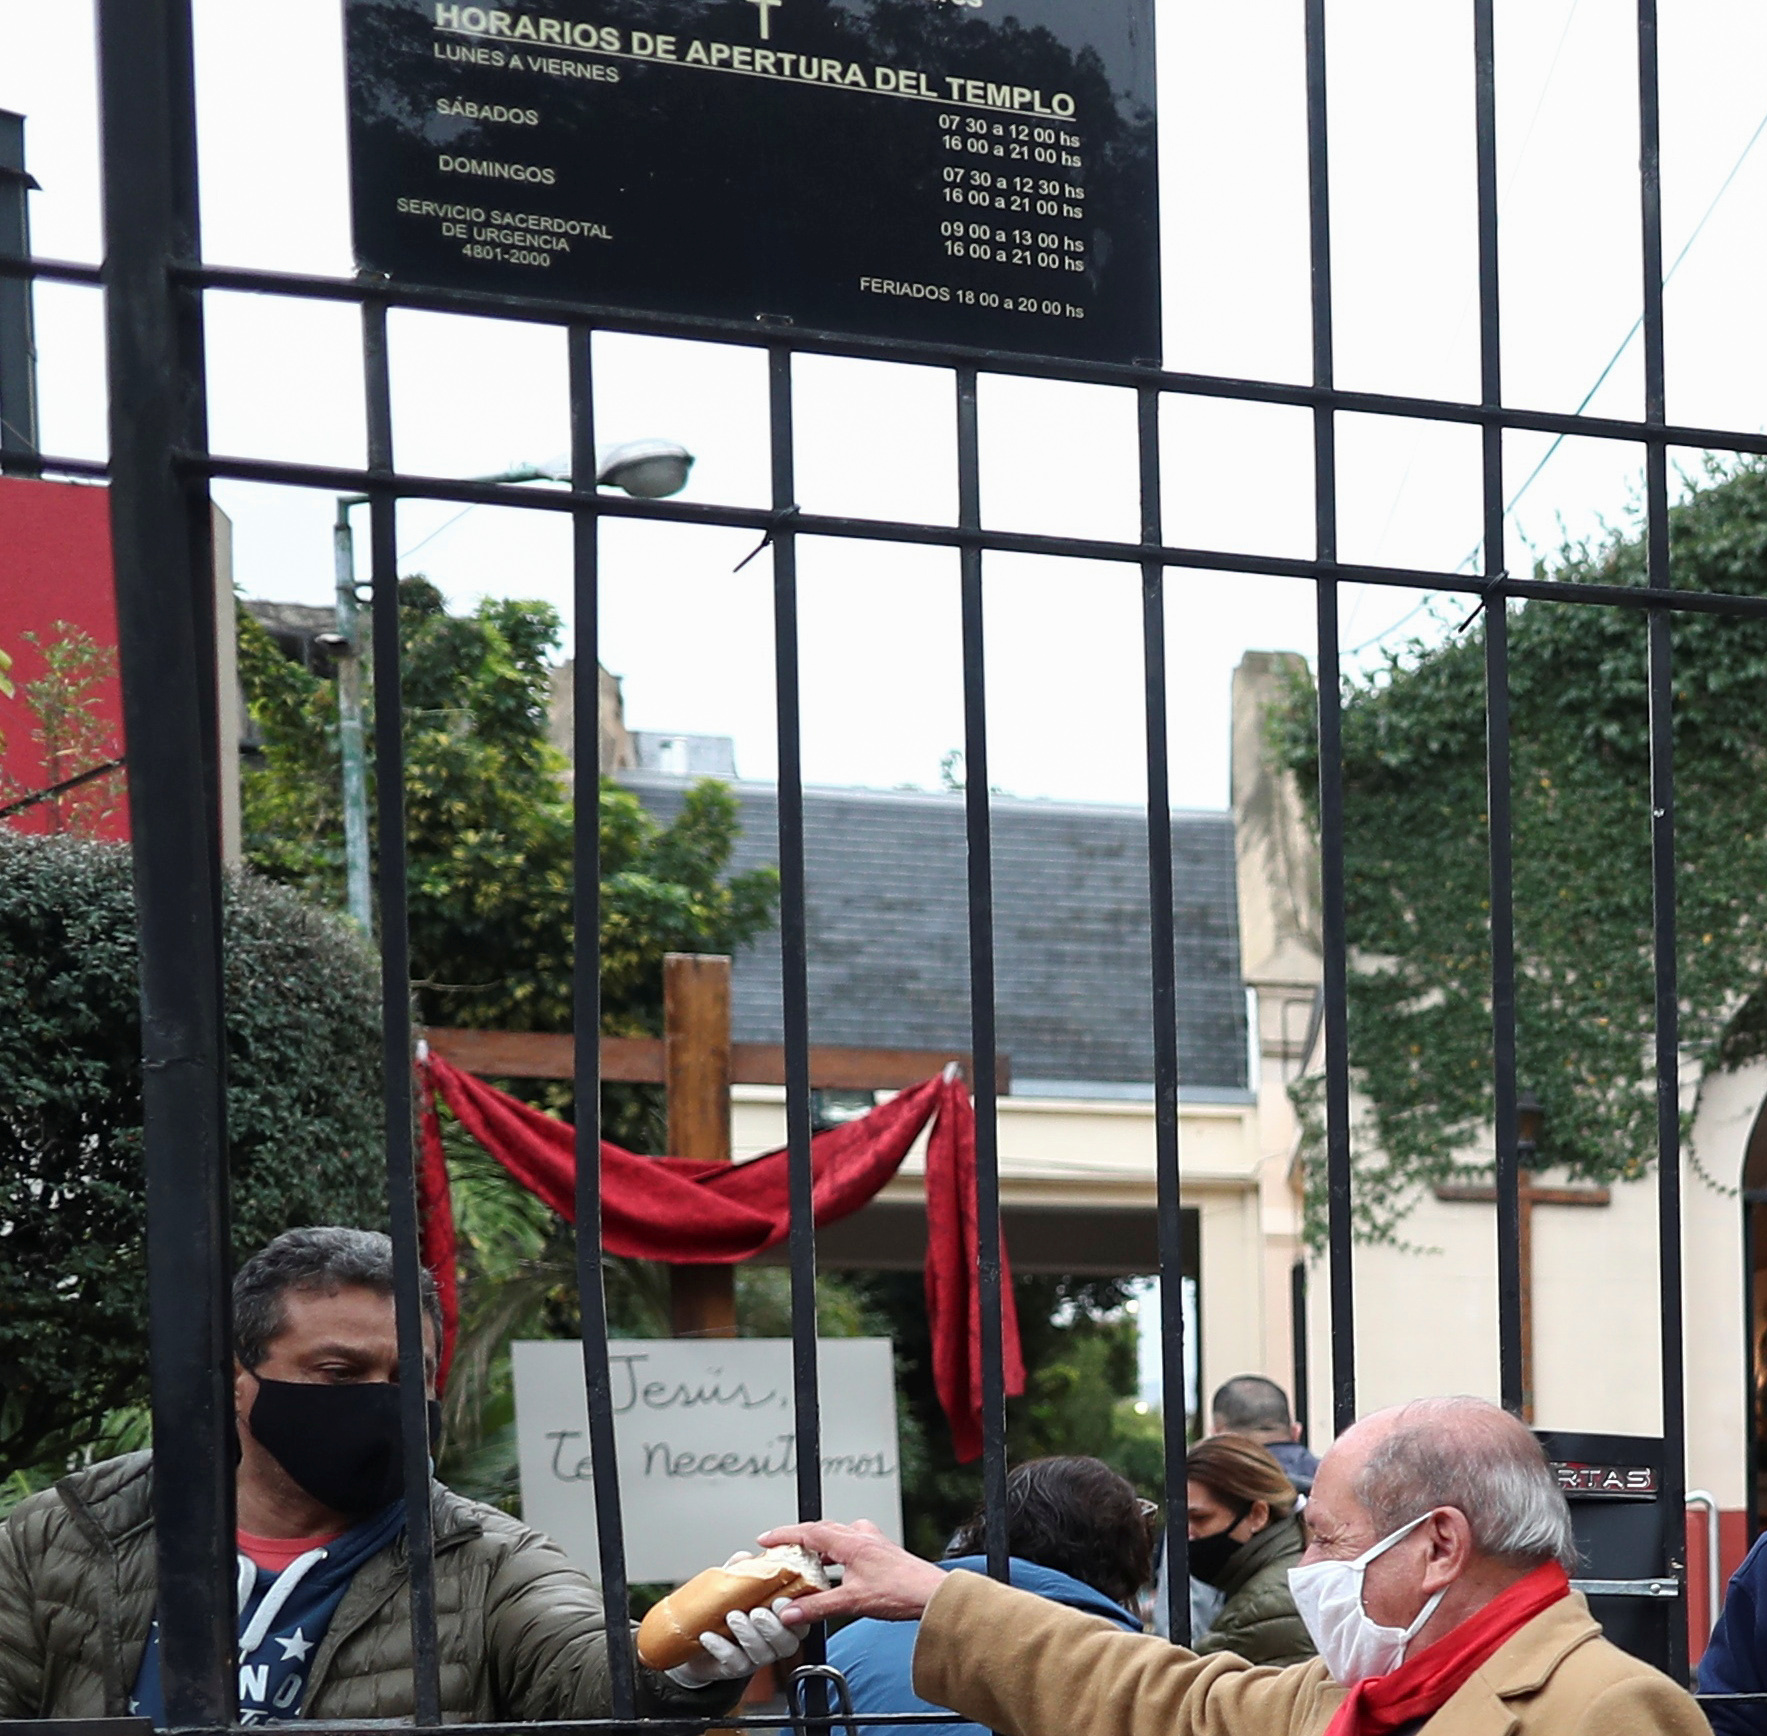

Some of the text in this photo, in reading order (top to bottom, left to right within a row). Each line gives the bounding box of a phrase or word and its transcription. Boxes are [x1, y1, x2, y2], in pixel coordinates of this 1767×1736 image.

[434, 42, 620, 83] LUNES A VIERNES
[435, 3, 1075, 116] HORARIOS DE APERTURA DEL TEMPLO
[436, 96, 539, 125] SÁBADOS
[939, 114, 1080, 147] 07 30 a 12 00 hs
[942, 135, 1081, 167] 16 00 a 21 00 hs
[439, 155, 556, 184] DOMINGOS
[943, 167, 1085, 200] 07 30 a 12 30 hs
[397, 198, 613, 239] SERVICIO SACERDOTAL
[943, 188, 1083, 219] 16 00 a 21 00 hs
[441, 222, 570, 252] DE URGENCIA
[941, 221, 1084, 252] 09 00 a 13 00 hs
[462, 243, 550, 267] 4801-2000
[944, 240, 1084, 272] 16 00 a 21 00 hs
[860, 277, 1084, 318] FERIADOS 18 00 a 20 00 hs
[546, 1429, 594, 1483] Te
[1558, 1468, 1650, 1488] RTAS
